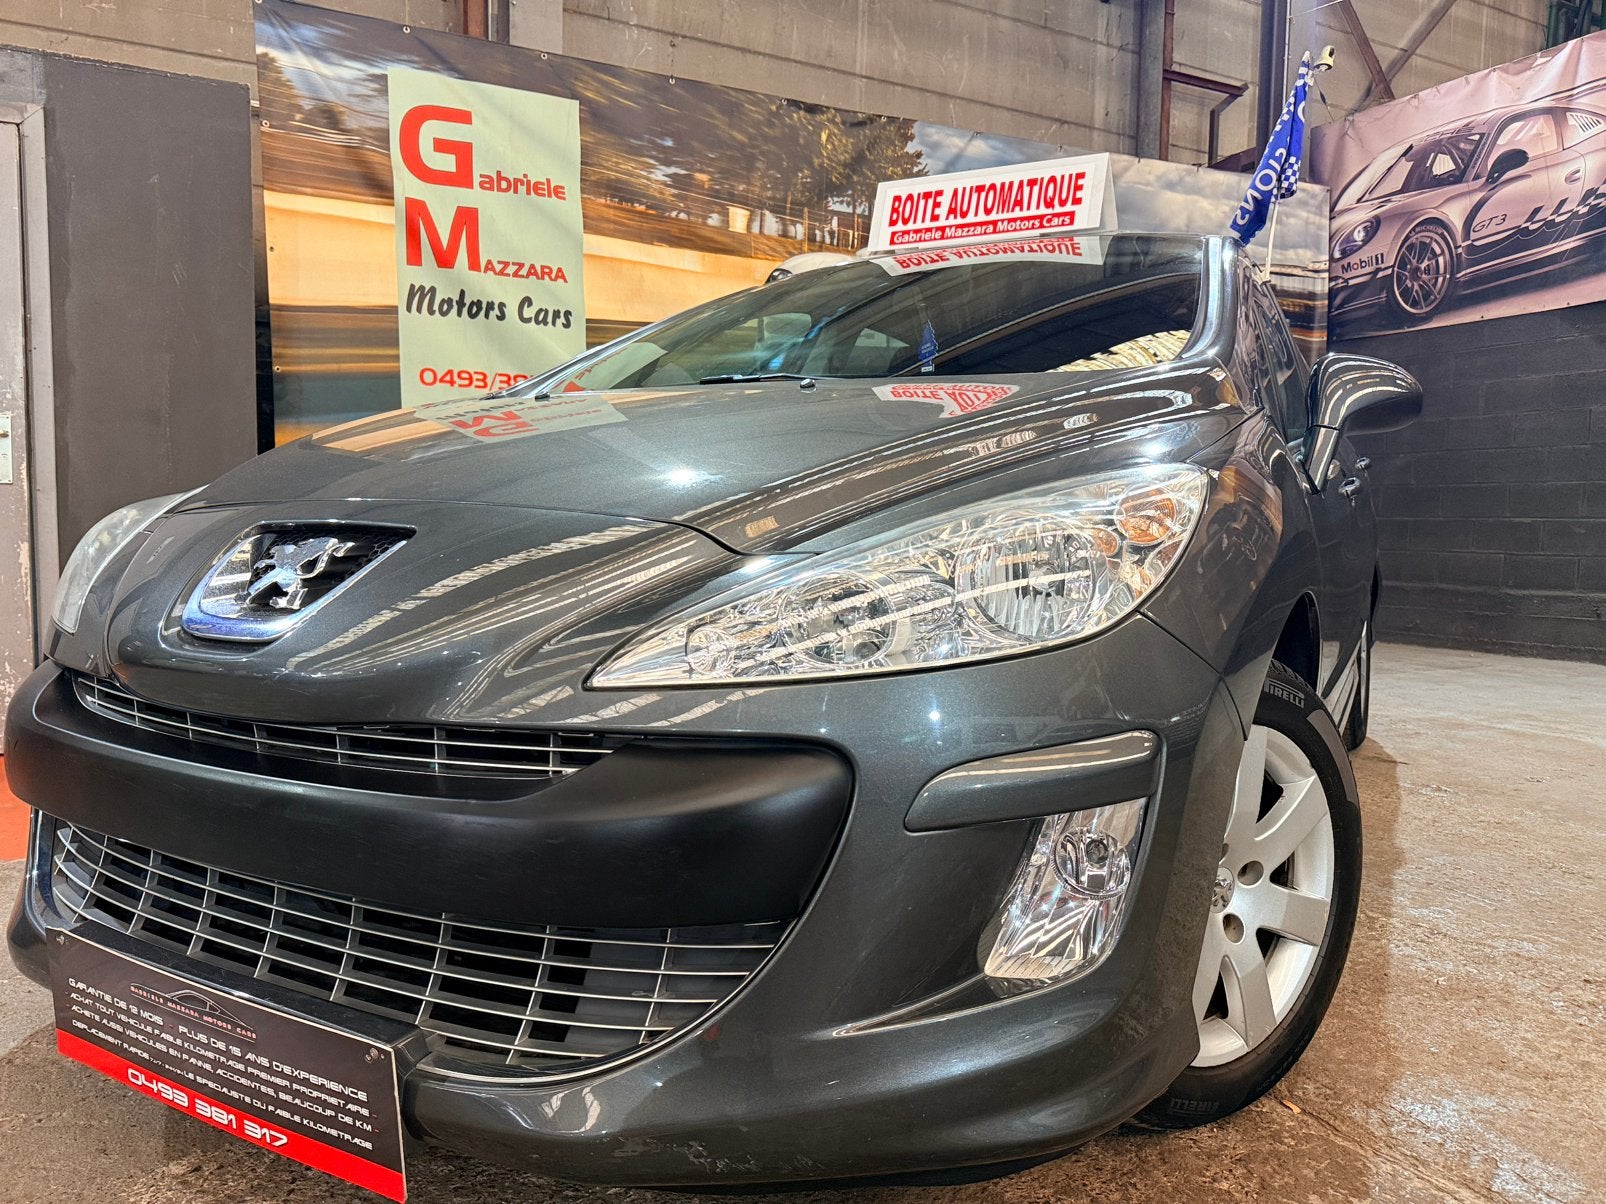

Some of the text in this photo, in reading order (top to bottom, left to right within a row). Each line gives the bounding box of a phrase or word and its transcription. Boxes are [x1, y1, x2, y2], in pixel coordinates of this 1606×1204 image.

[404, 196, 568, 283] MAZZARA
[889, 172, 1086, 227] BOITE AUTOMATIQUE
[893, 214, 1070, 244] Gabriele Mazzara Motors Cars
[1341, 257, 1374, 275] Mobil
[405, 283, 573, 330] Motors Cars
[68, 977, 113, 1004] GARANTIE
[113, 997, 128, 1011] DE
[128, 1004, 139, 1015] 12
[139, 1009, 164, 1026] MOIS
[178, 1024, 209, 1044] PLUS
[210, 1037, 227, 1051] DE
[228, 1045, 242, 1057] 15
[244, 1052, 270, 1068] ANS
[272, 1060, 368, 1103] D'EXPERIENCE
[70, 992, 94, 1007] ACHAT
[95, 1001, 115, 1016] TOUT
[116, 1011, 153, 1034] VEHICULE
[183, 1041, 246, 1072] KILOMETRAGE
[247, 1066, 291, 1089] PREMIER
[71, 1004, 101, 1022] ACHETE
[101, 1018, 124, 1034] AUSSI
[124, 1028, 168, 1053] VEHICULES
[168, 1047, 181, 1059] EN
[215, 1068, 277, 1099] ACCIDENTES,
[278, 1091, 336, 1117] BEAUCOUP
[337, 1113, 354, 1126] DE
[354, 1119, 373, 1132] KM
[127, 1067, 288, 1147] 0493 381 317
[183, 1070, 195, 1081] LE
[195, 1075, 252, 1104] SPECIALISTE
[252, 1098, 267, 1110] DU
[302, 1117, 373, 1151] KILOMETRAGE
